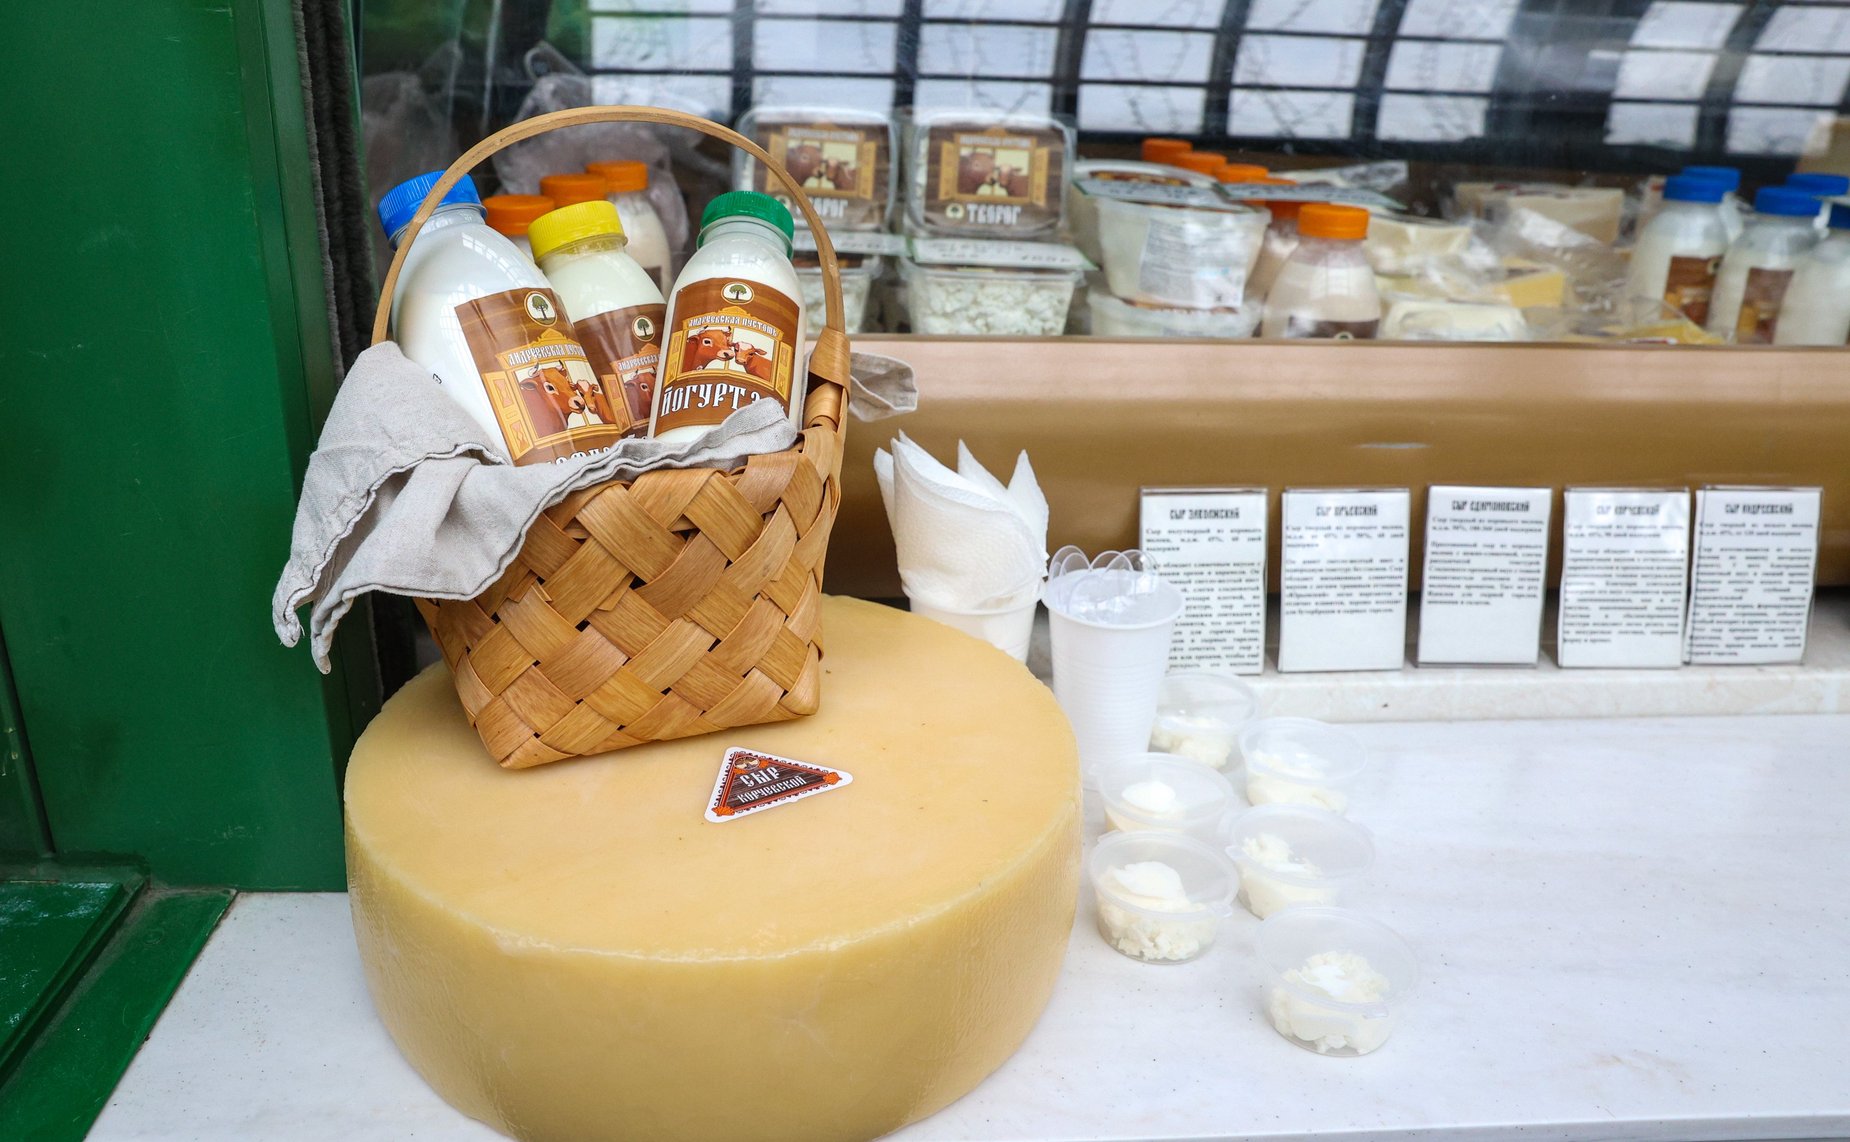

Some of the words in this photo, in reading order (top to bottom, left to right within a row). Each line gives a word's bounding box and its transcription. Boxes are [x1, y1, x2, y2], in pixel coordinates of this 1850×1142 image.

[966, 203, 1022, 225] ТВОРОГ
[688, 315, 741, 328] АНДРЕЕВСКАЯ
[742, 318, 778, 337] ПУСТОШЬ
[508, 344, 565, 367] АНДРЕЕВСКАЯ
[660, 382, 747, 418] ЙОГУРТ
[1169, 508, 1186, 520] СЫР
[739, 766, 781, 787] СЫР
[736, 775, 807, 804] КОРЧЕВСКОЙ
